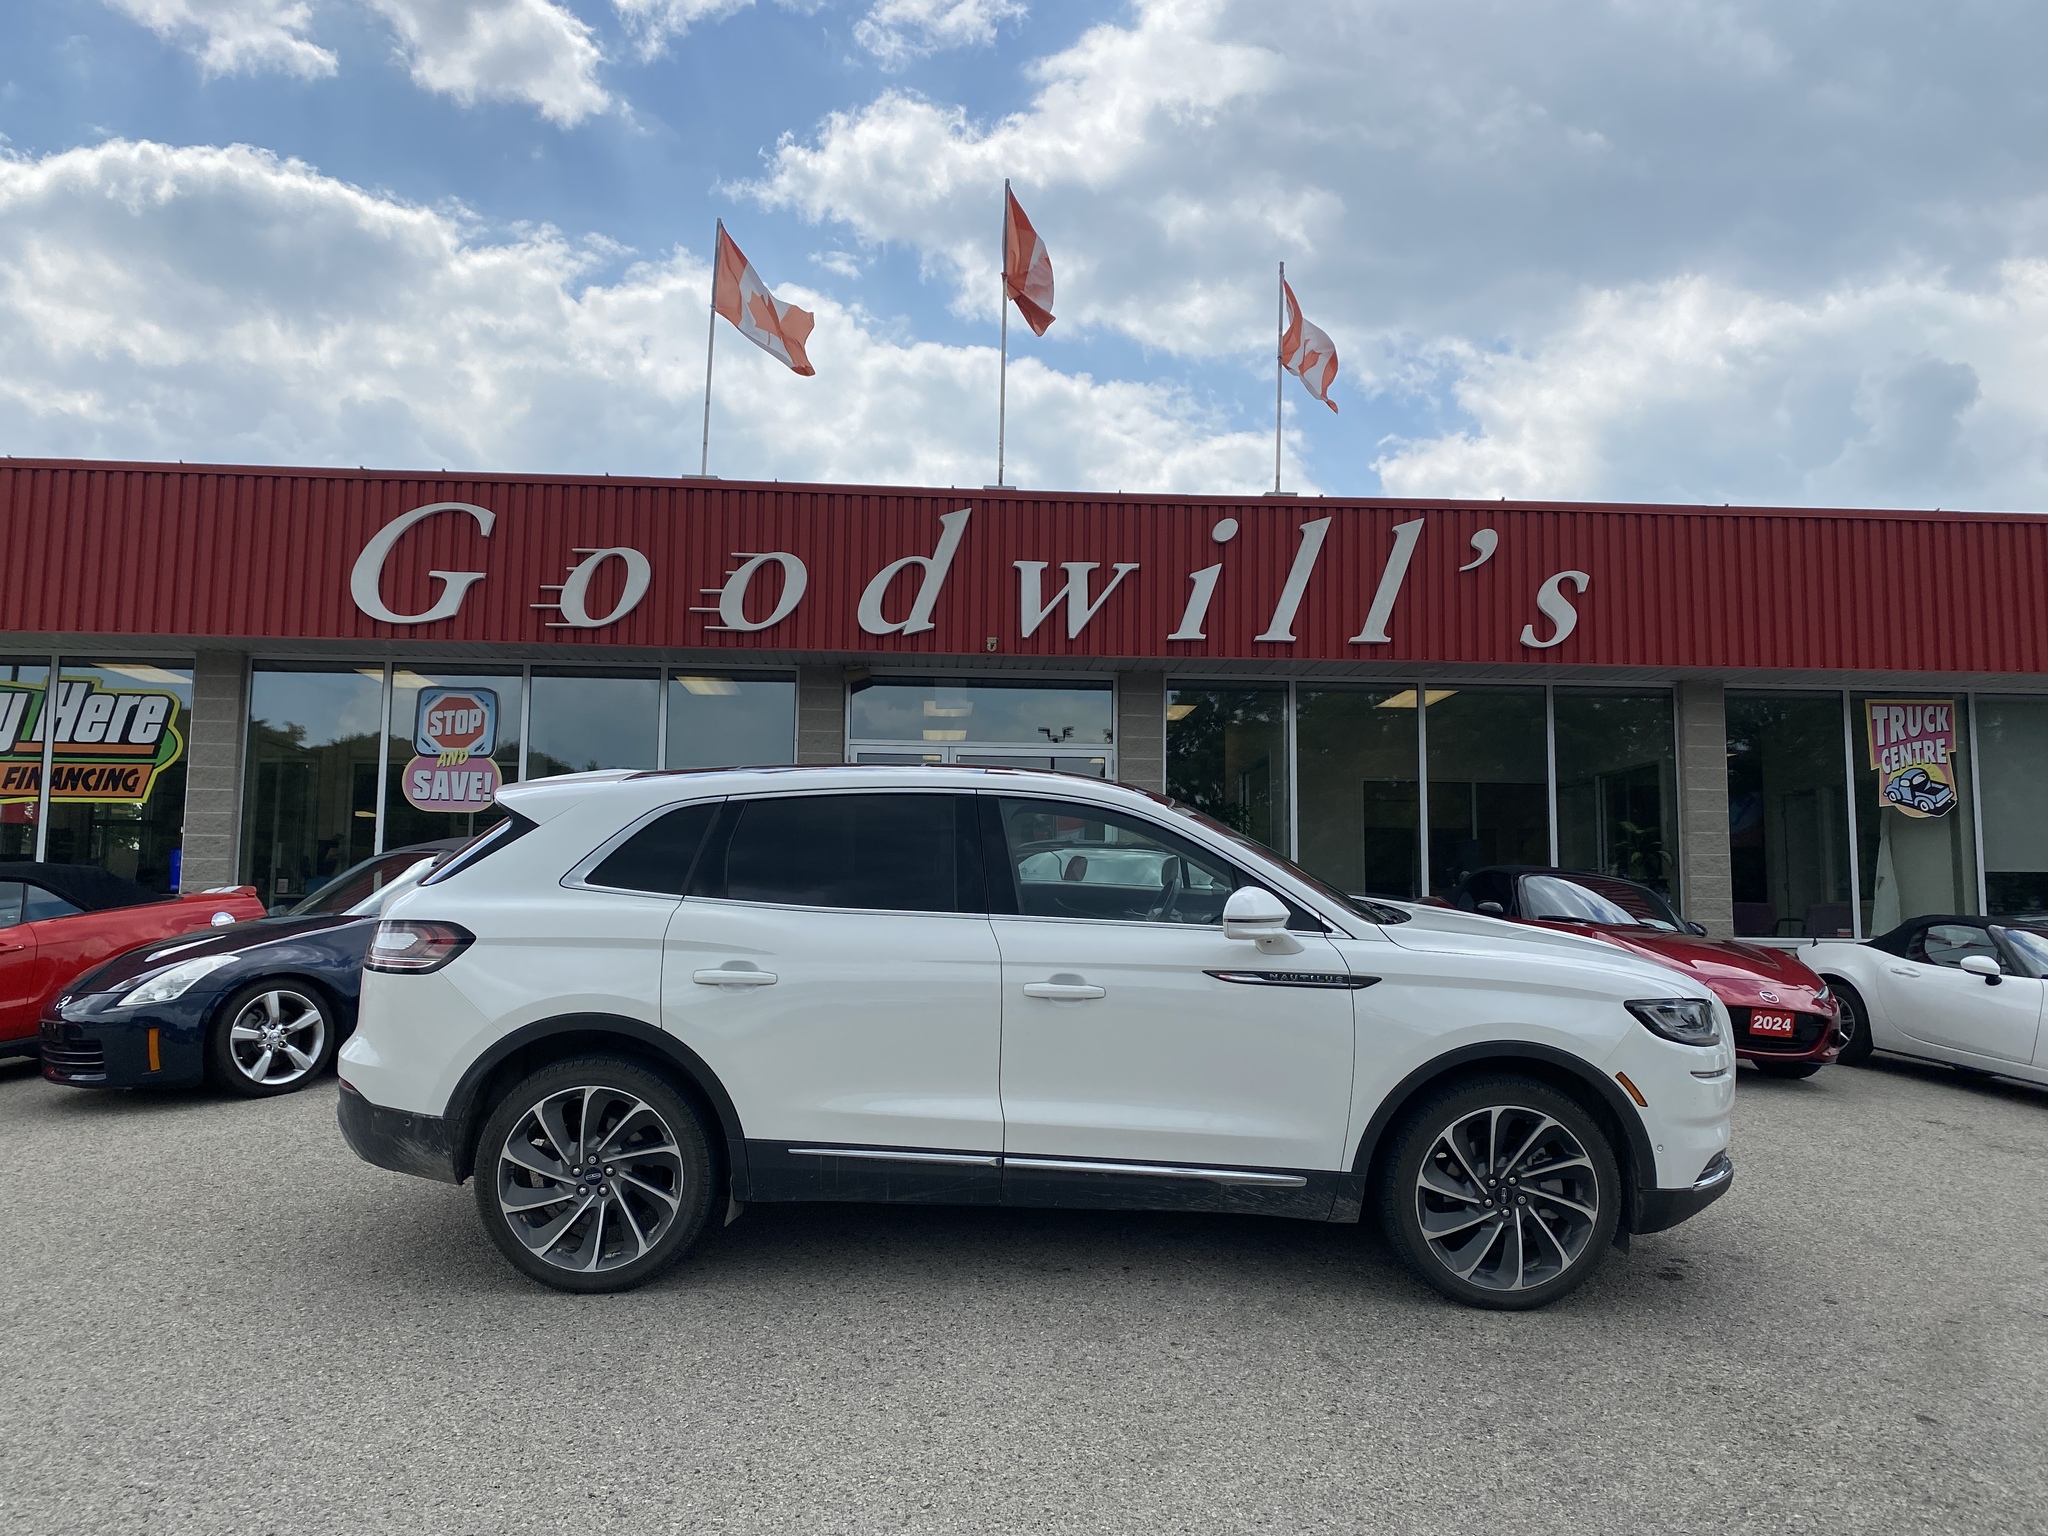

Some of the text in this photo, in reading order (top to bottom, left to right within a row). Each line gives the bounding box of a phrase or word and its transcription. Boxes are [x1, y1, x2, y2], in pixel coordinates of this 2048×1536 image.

[350, 501, 1590, 648] Goodwill's
[31, 682, 169, 743] Here
[429, 708, 482, 736] STOP
[1872, 706, 1949, 746] TRUCK
[436, 750, 469, 768] AND
[1881, 738, 1947, 774] CENTRE
[1, 766, 141, 792] FINANCING
[412, 769, 493, 802] SAVE!
[1269, 973, 1344, 983] NAUTILUS
[1753, 1015, 1791, 1032] 2024
